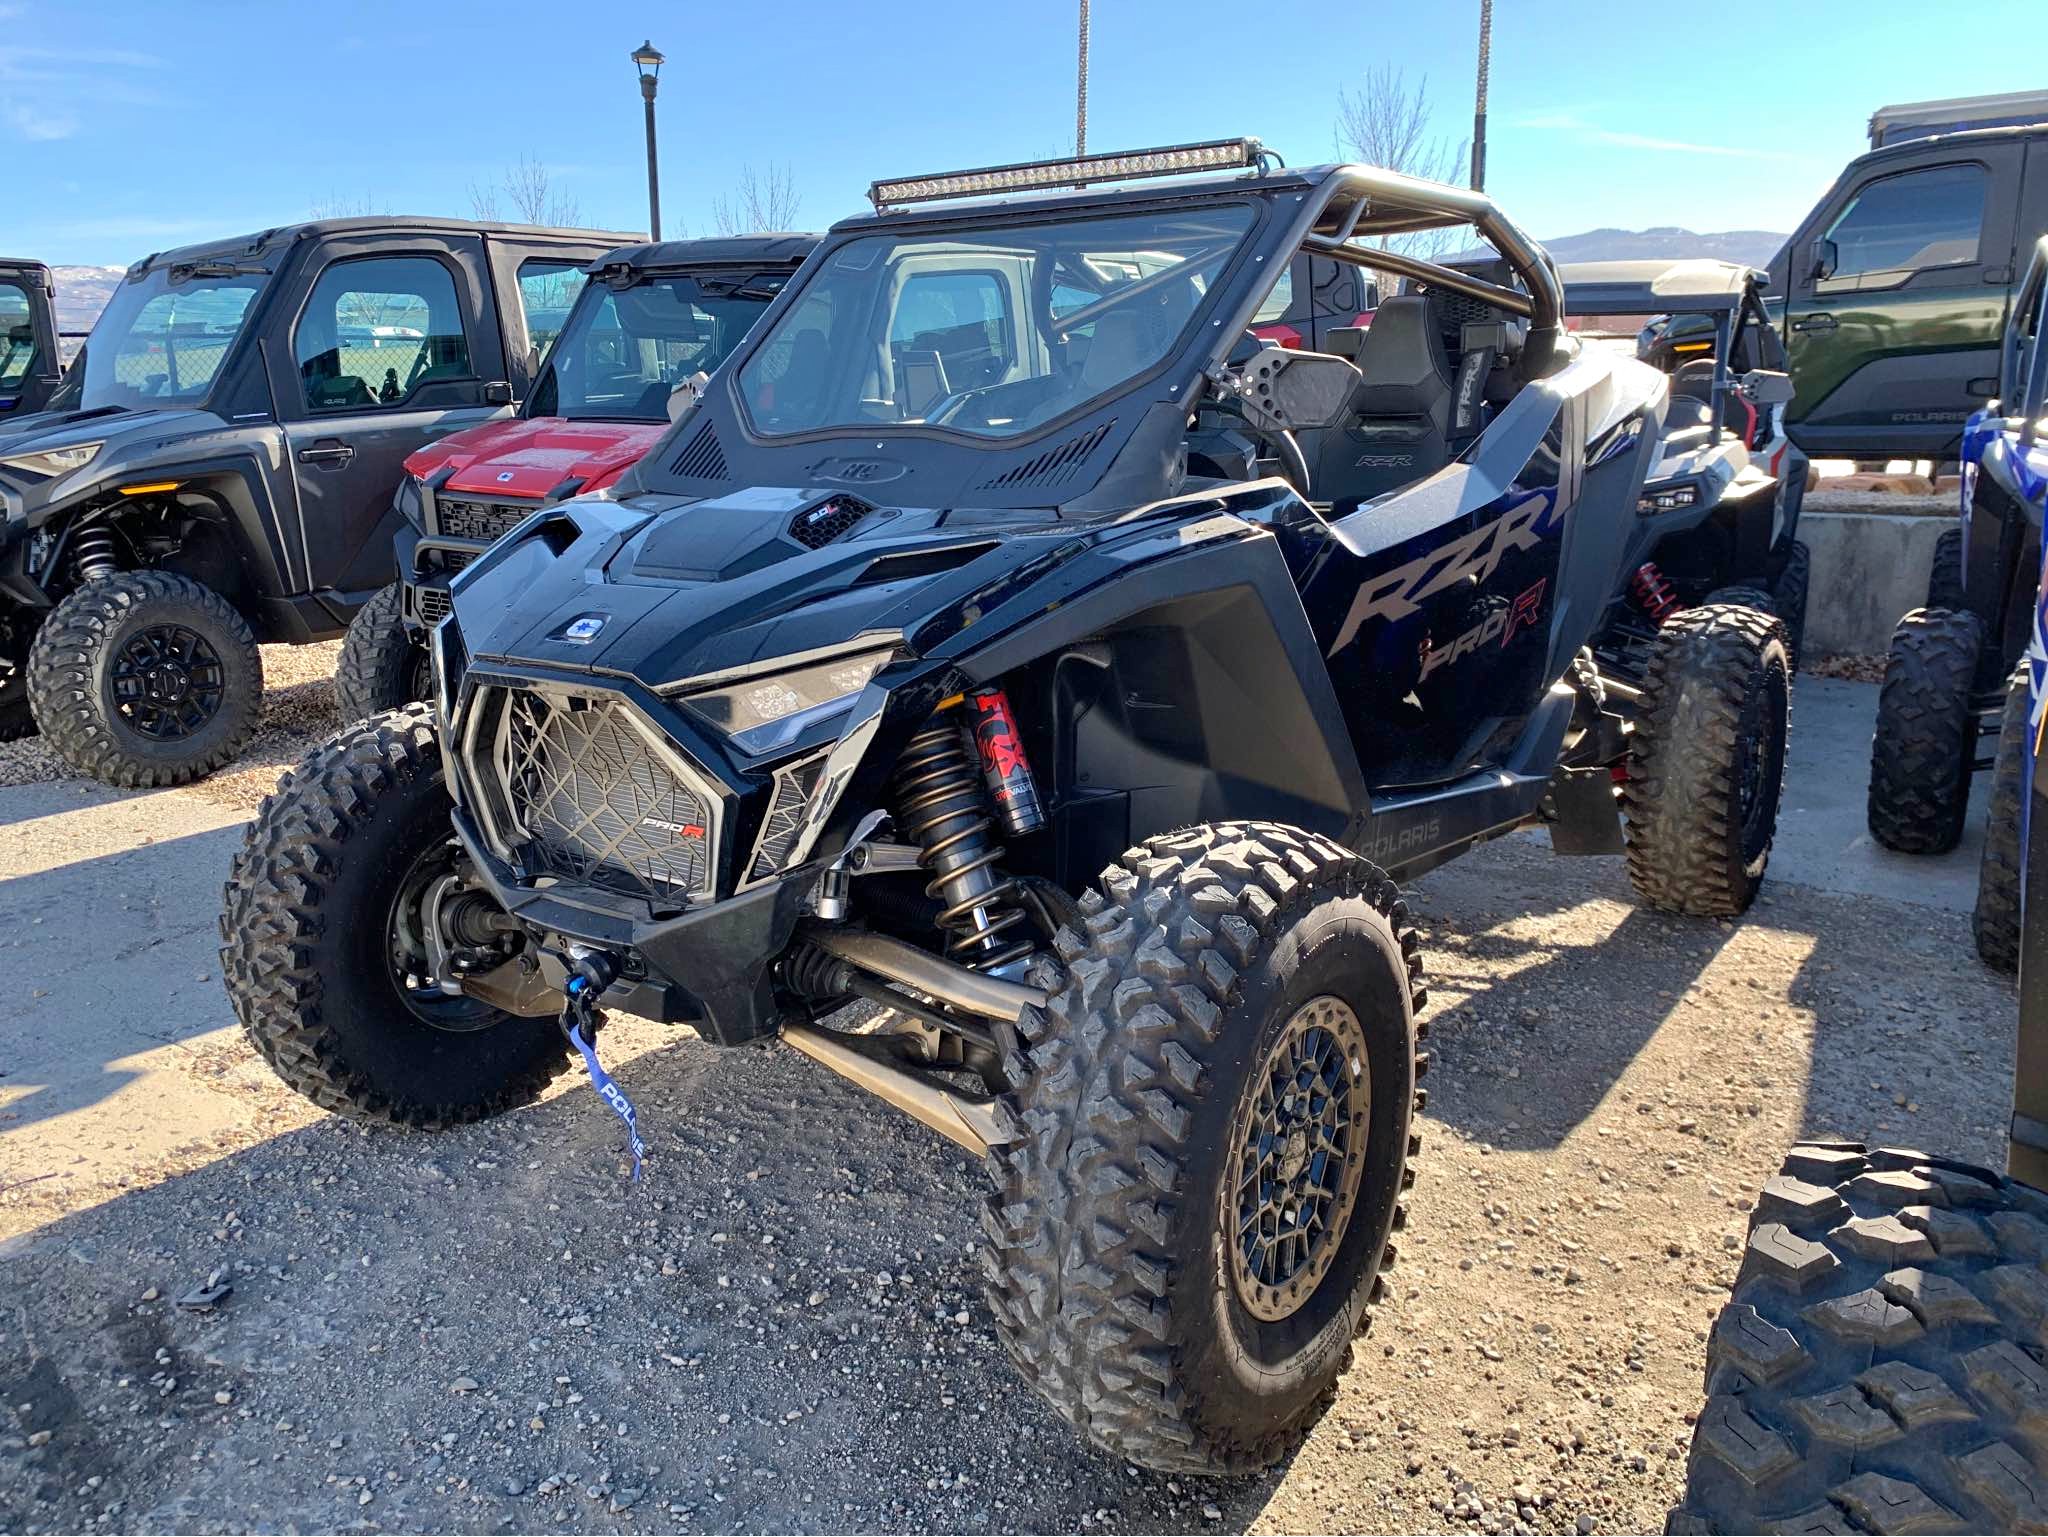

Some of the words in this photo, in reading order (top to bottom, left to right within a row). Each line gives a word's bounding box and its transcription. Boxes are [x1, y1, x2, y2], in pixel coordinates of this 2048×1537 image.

[1355, 455, 1414, 467] RZR
[1326, 493, 1549, 660] RZR
[976, 690, 1031, 778] FOX
